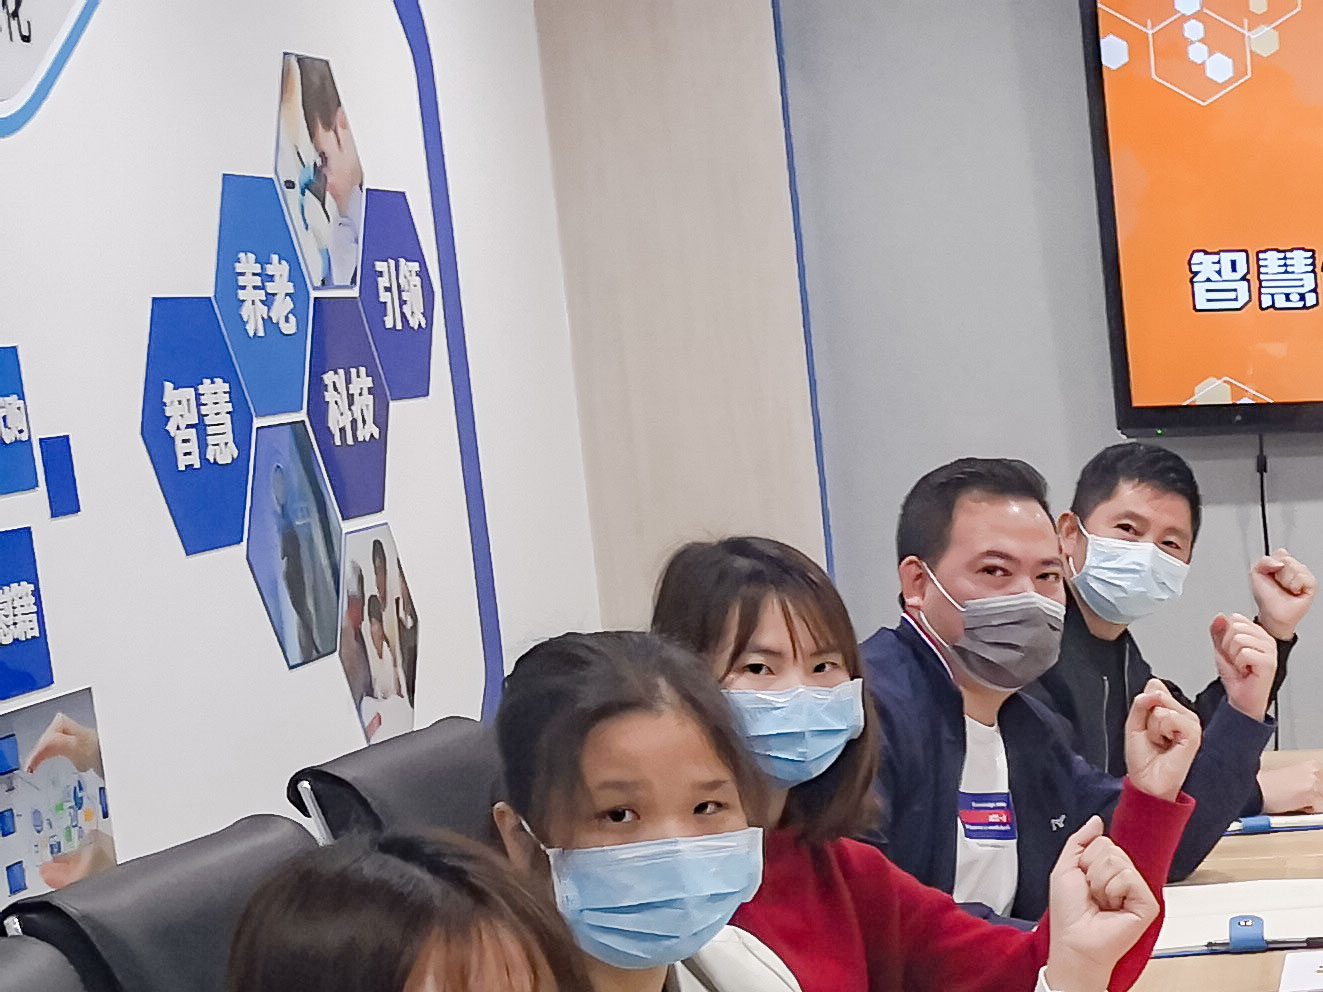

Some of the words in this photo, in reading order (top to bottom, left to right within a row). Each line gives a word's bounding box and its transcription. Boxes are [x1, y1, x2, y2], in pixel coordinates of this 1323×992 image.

[234, 252, 297, 338] 养老
[374, 257, 427, 331] 引领
[162, 377, 239, 471] 智慧
[322, 366, 380, 447] 科技
